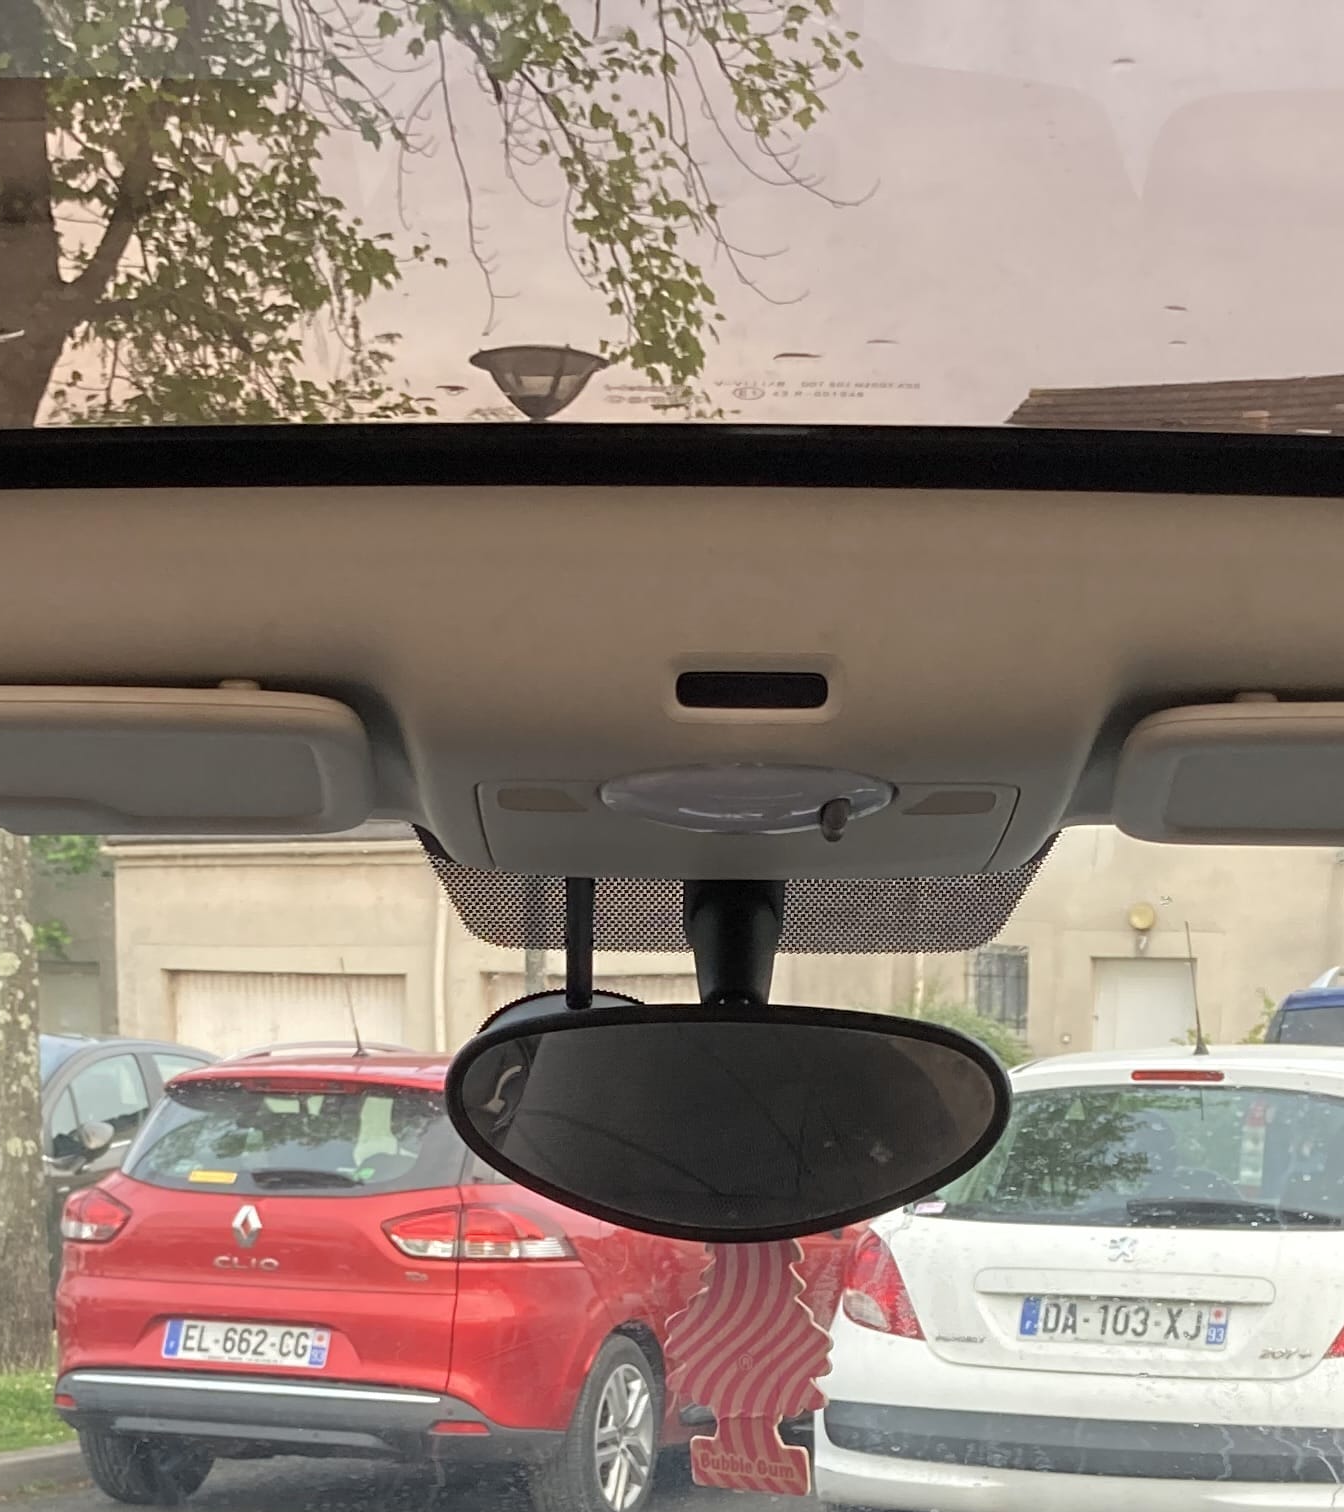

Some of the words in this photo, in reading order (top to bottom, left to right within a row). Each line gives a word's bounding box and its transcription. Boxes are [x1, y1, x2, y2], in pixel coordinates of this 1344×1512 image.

[213, 1256, 279, 1270] CLIO
[1042, 1302, 1204, 1341] DA-103-XJ
[1207, 1327, 1225, 1342] 93
[182, 1324, 310, 1359] EL-662-CG
[699, 1452, 753, 1474] Bubble
[757, 1459, 795, 1479] Gum
